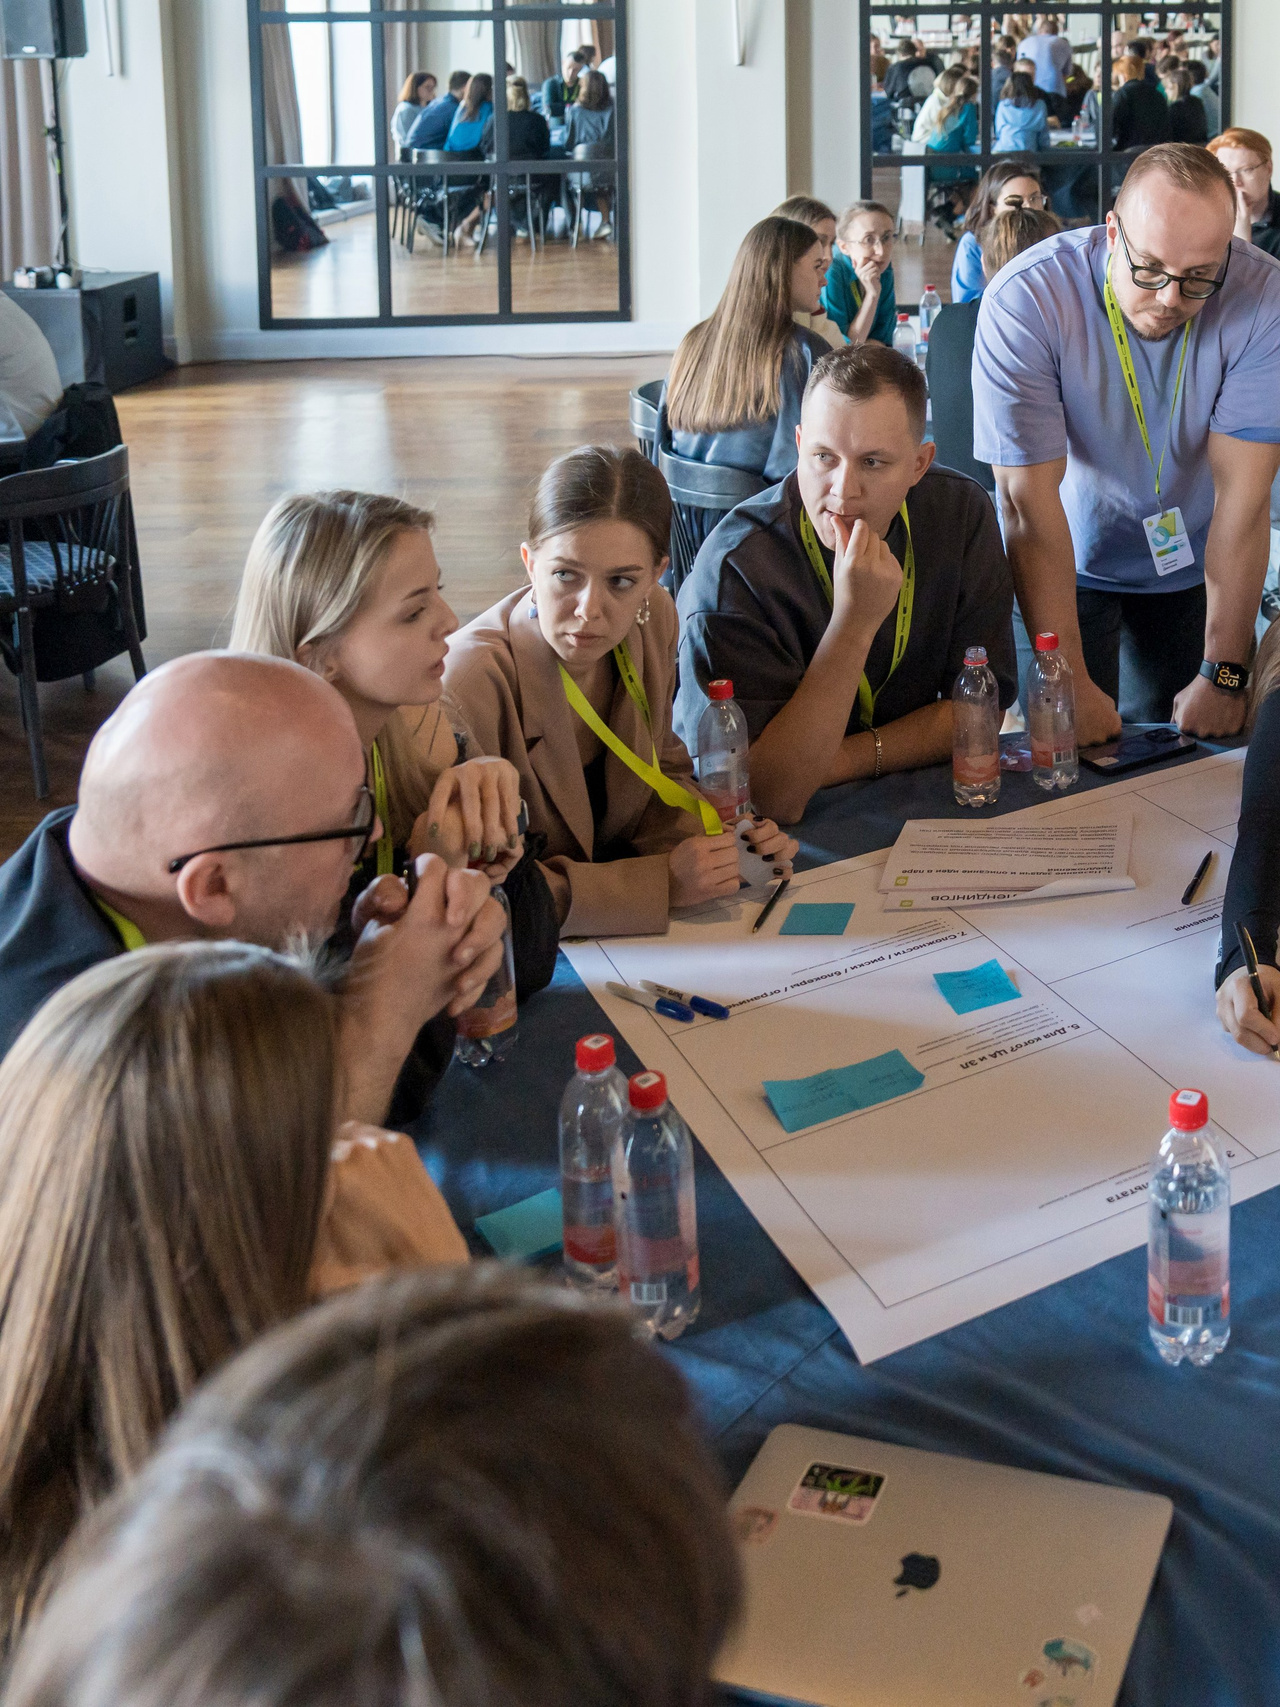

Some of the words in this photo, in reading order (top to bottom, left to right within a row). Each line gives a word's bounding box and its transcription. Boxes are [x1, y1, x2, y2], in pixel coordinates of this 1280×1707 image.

[1227, 673, 1240, 687] 15
[1173, 912, 1219, 932] решения
[892, 933, 958, 957] Сложности
[848, 955, 886, 970] риски
[788, 969, 843, 989] блокеры
[1042, 1027, 1067, 1039] Для
[1066, 1023, 1080, 1031] 5.
[1008, 1036, 1042, 1051] кого?
[987, 1048, 1008, 1059] ЦА
